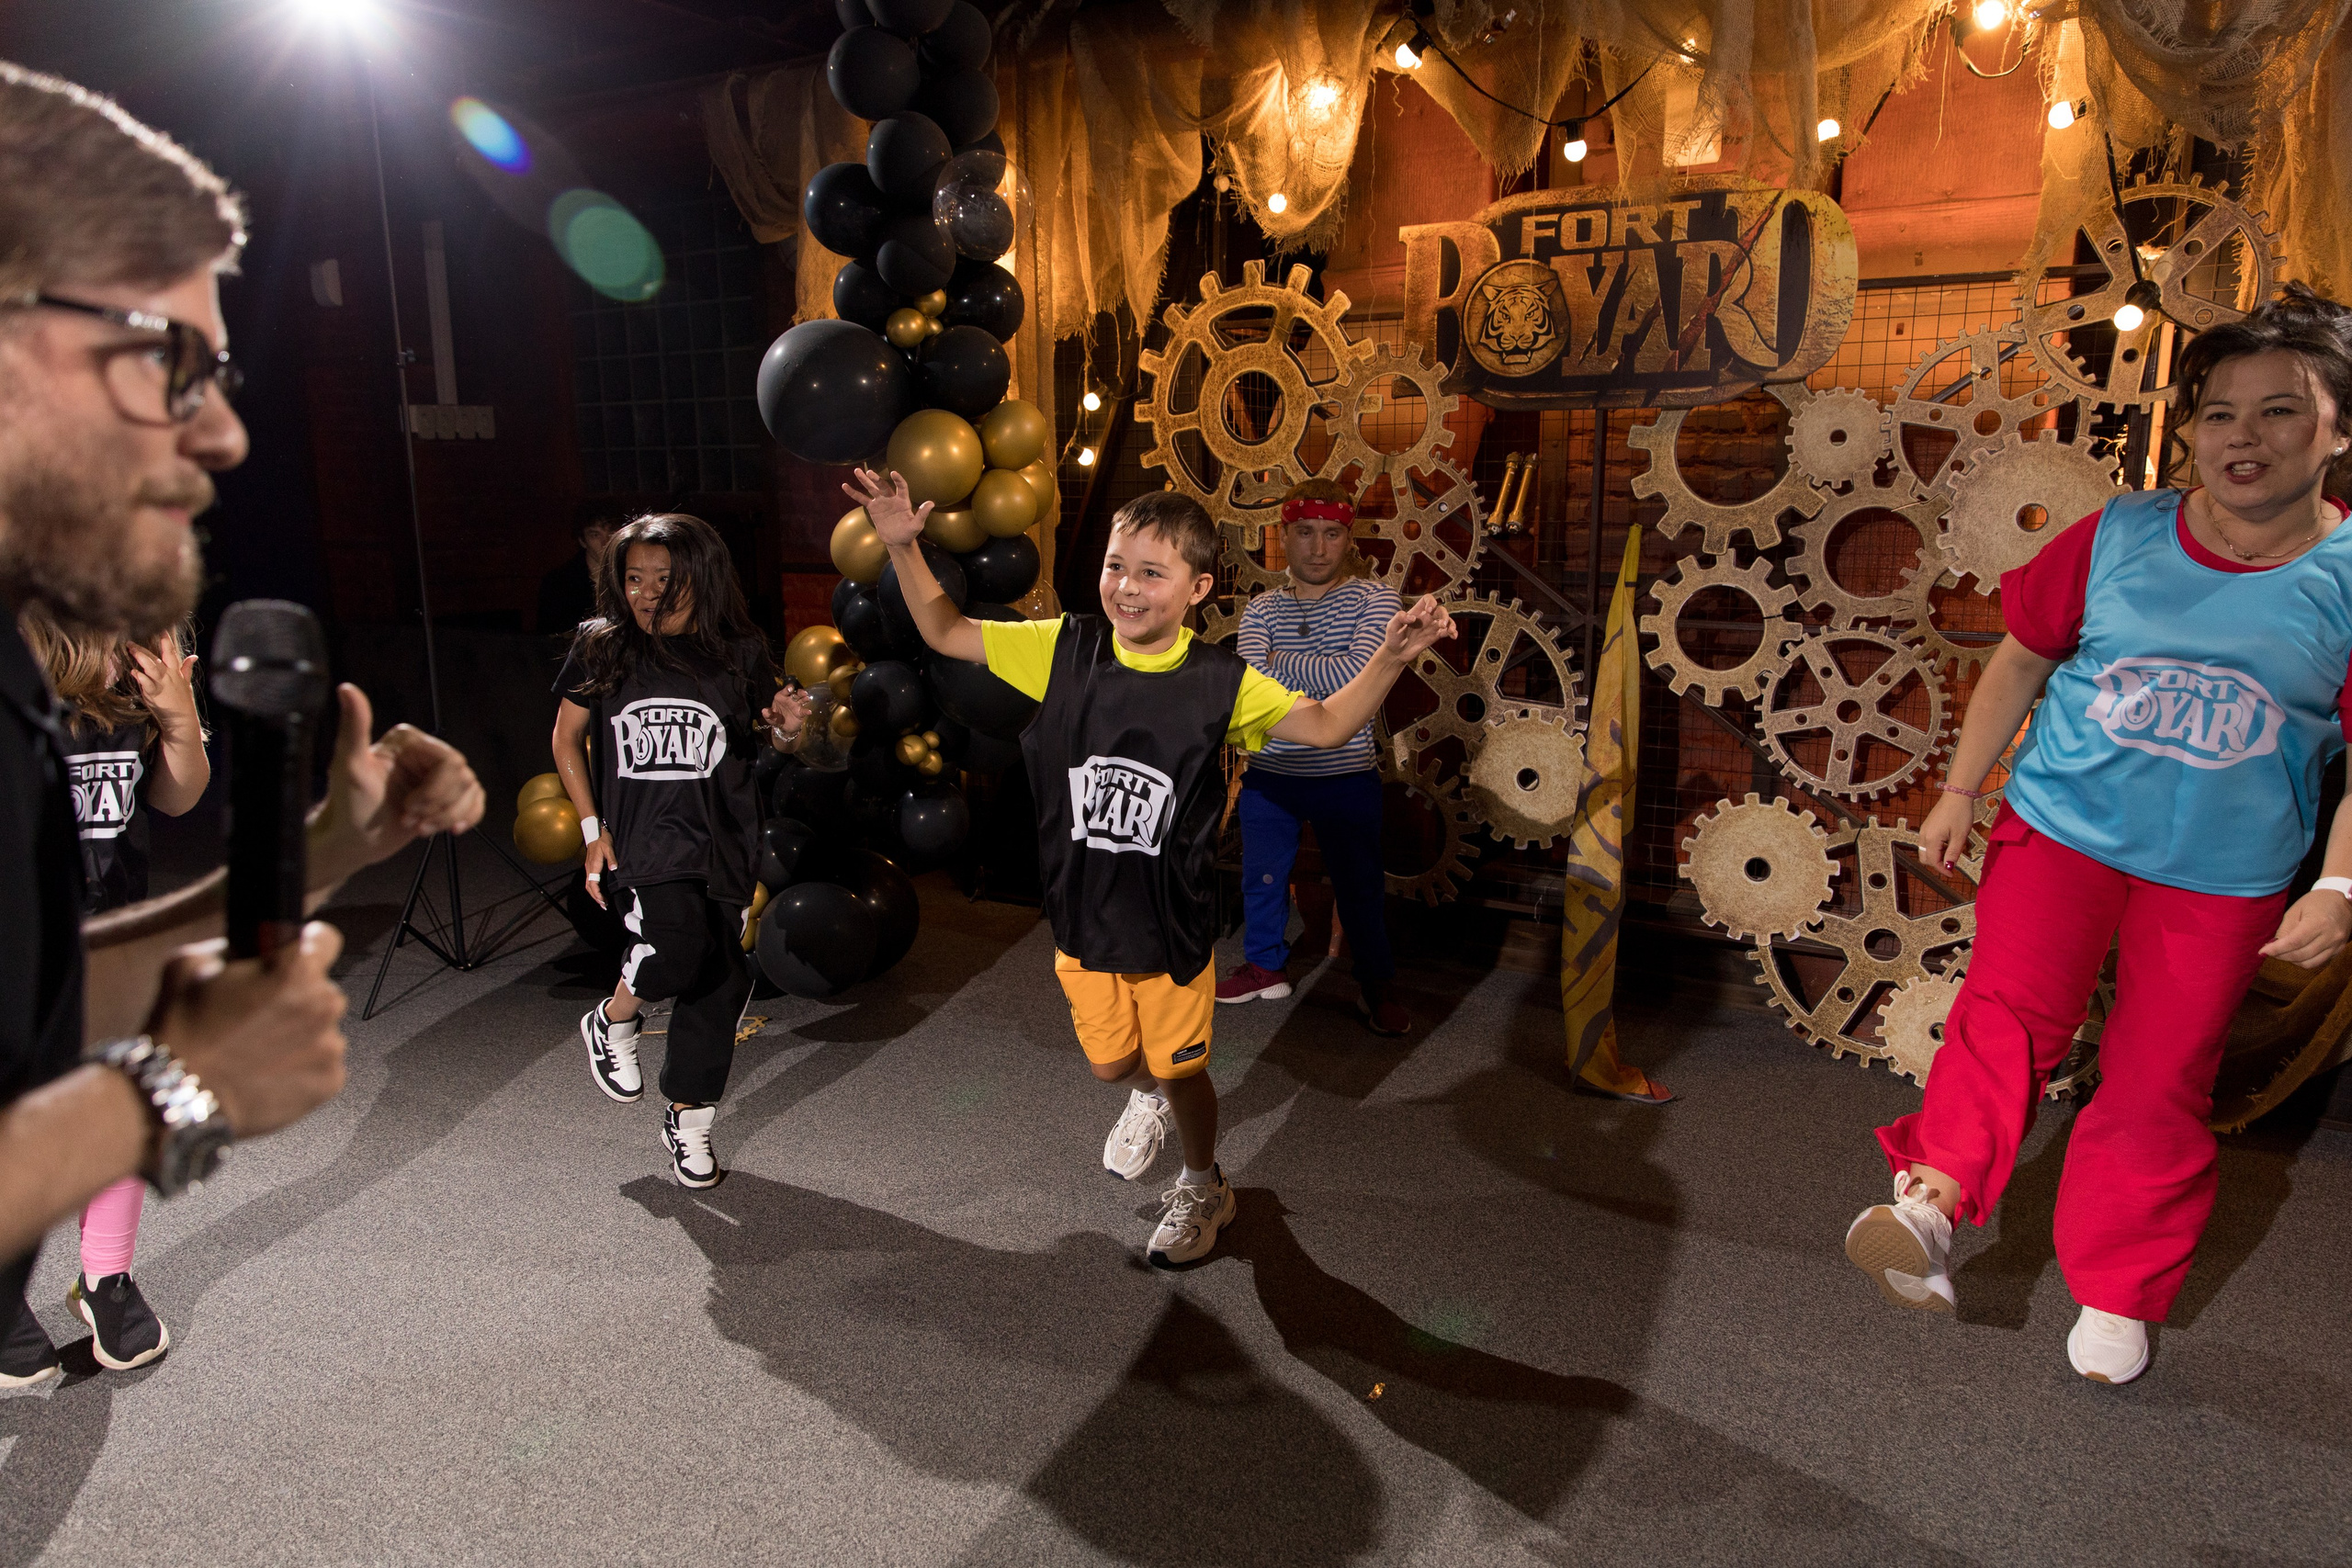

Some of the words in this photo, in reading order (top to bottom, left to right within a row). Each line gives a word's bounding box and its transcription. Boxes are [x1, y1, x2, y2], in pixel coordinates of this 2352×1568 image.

[1520, 198, 1703, 254] FORT
[2138, 669, 2236, 700] FORT
[639, 707, 700, 726] FORT
